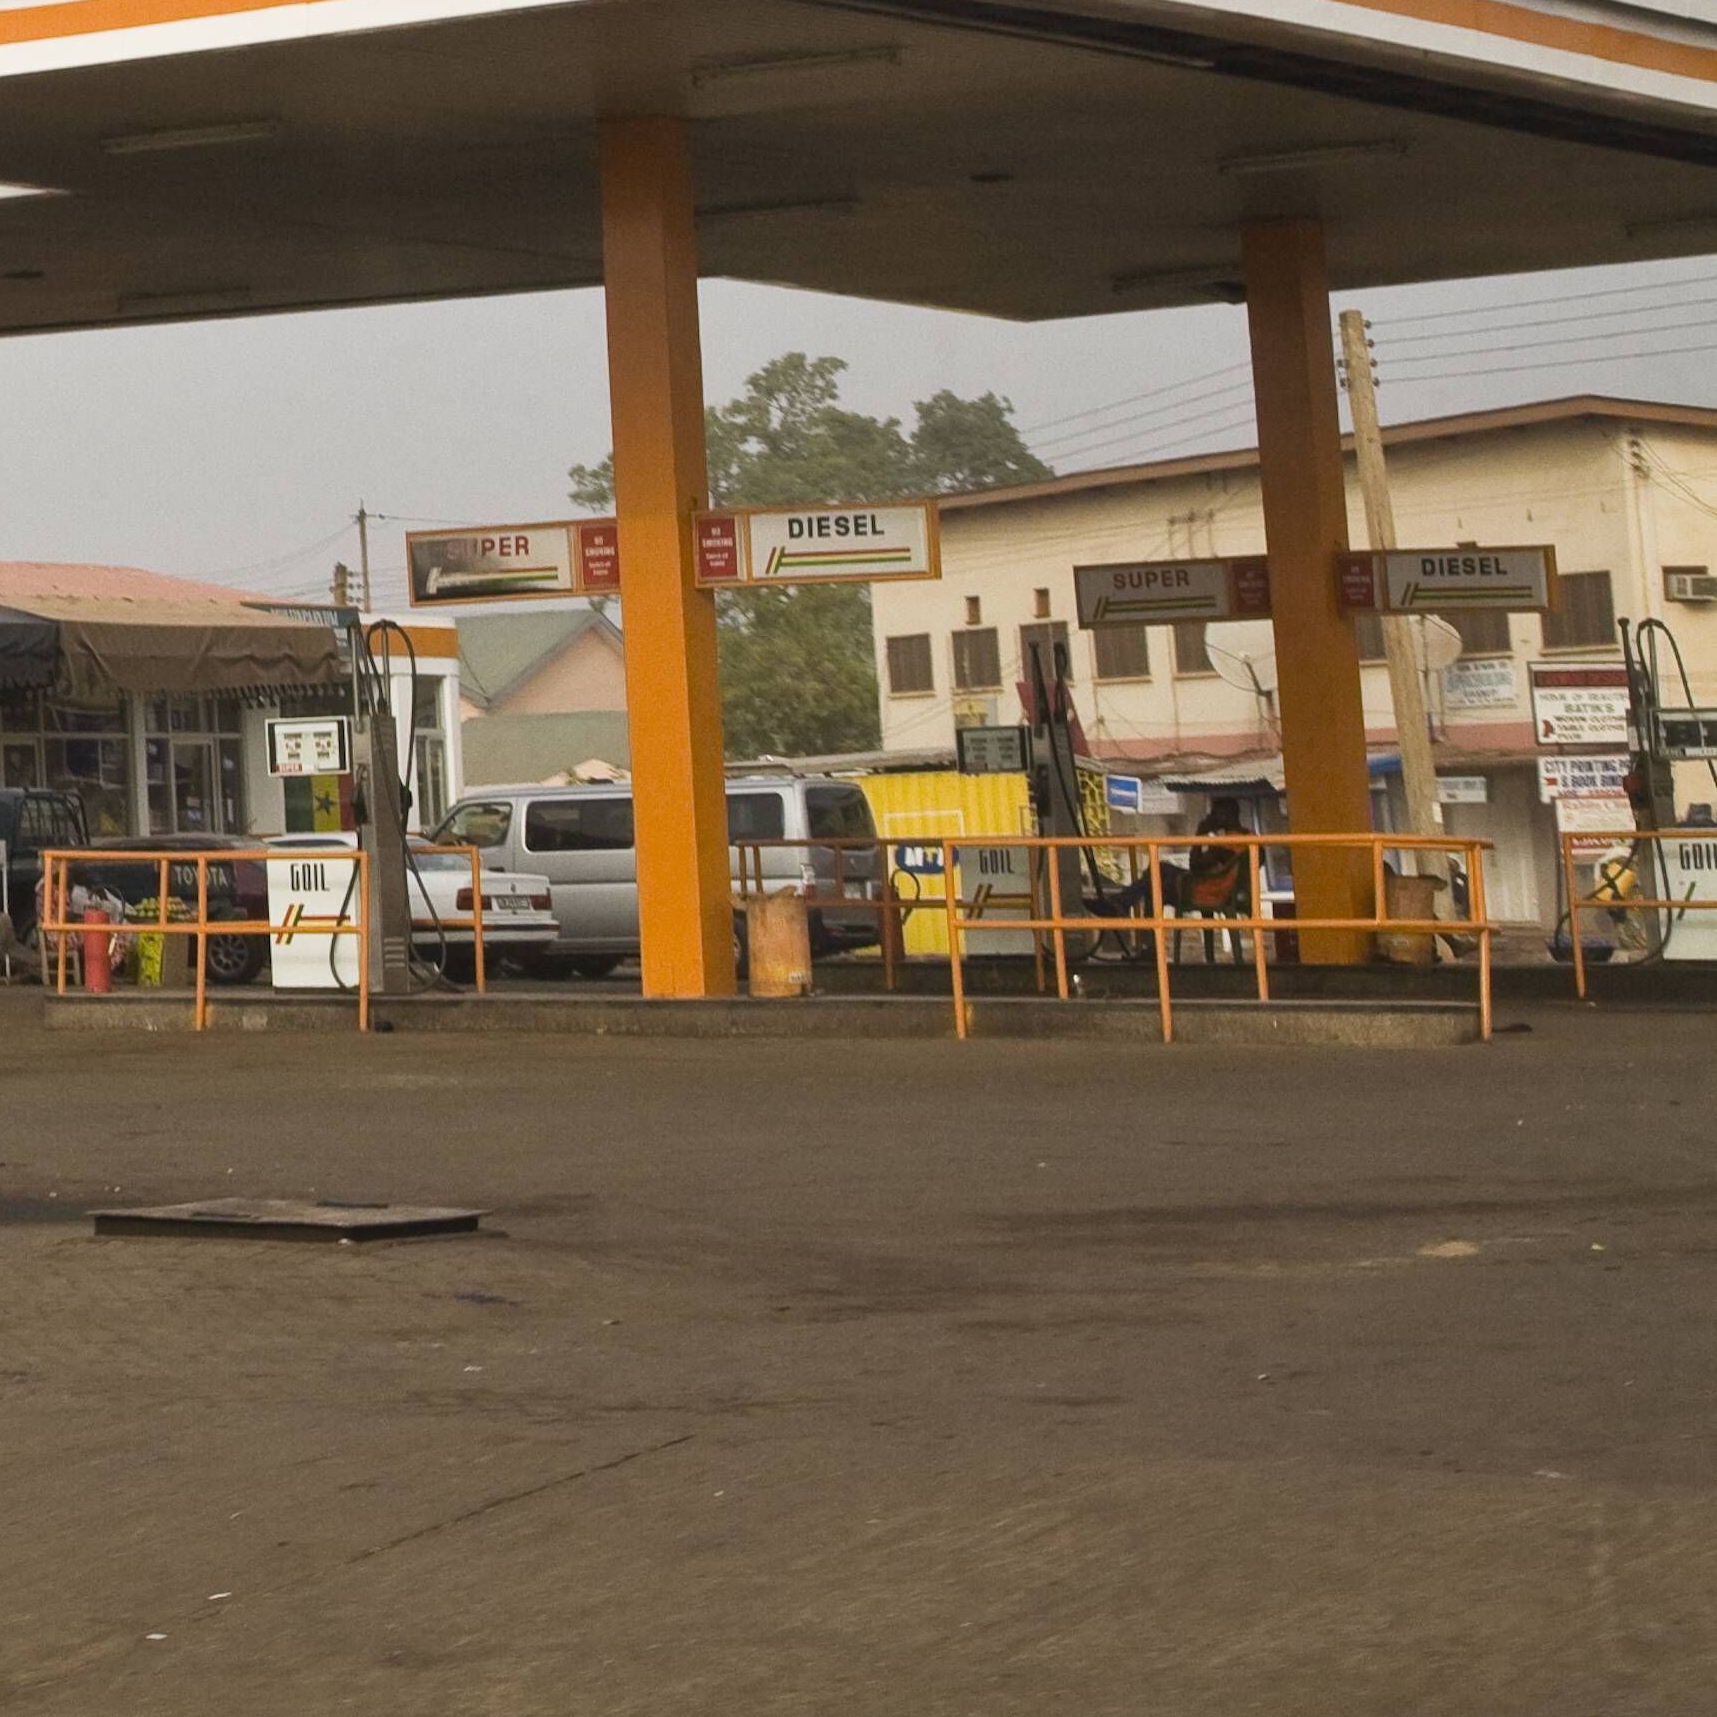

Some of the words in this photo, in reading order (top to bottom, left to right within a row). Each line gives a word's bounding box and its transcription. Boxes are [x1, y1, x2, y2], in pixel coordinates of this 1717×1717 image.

[787, 514, 885, 539] DIESEL
[1421, 557, 1508, 576] DIESEL
[1113, 570, 1190, 589] SUPER
[979, 849, 1015, 874] GOIL
[173, 865, 229, 887] TOYTA
[290, 862, 330, 892] GOIL
